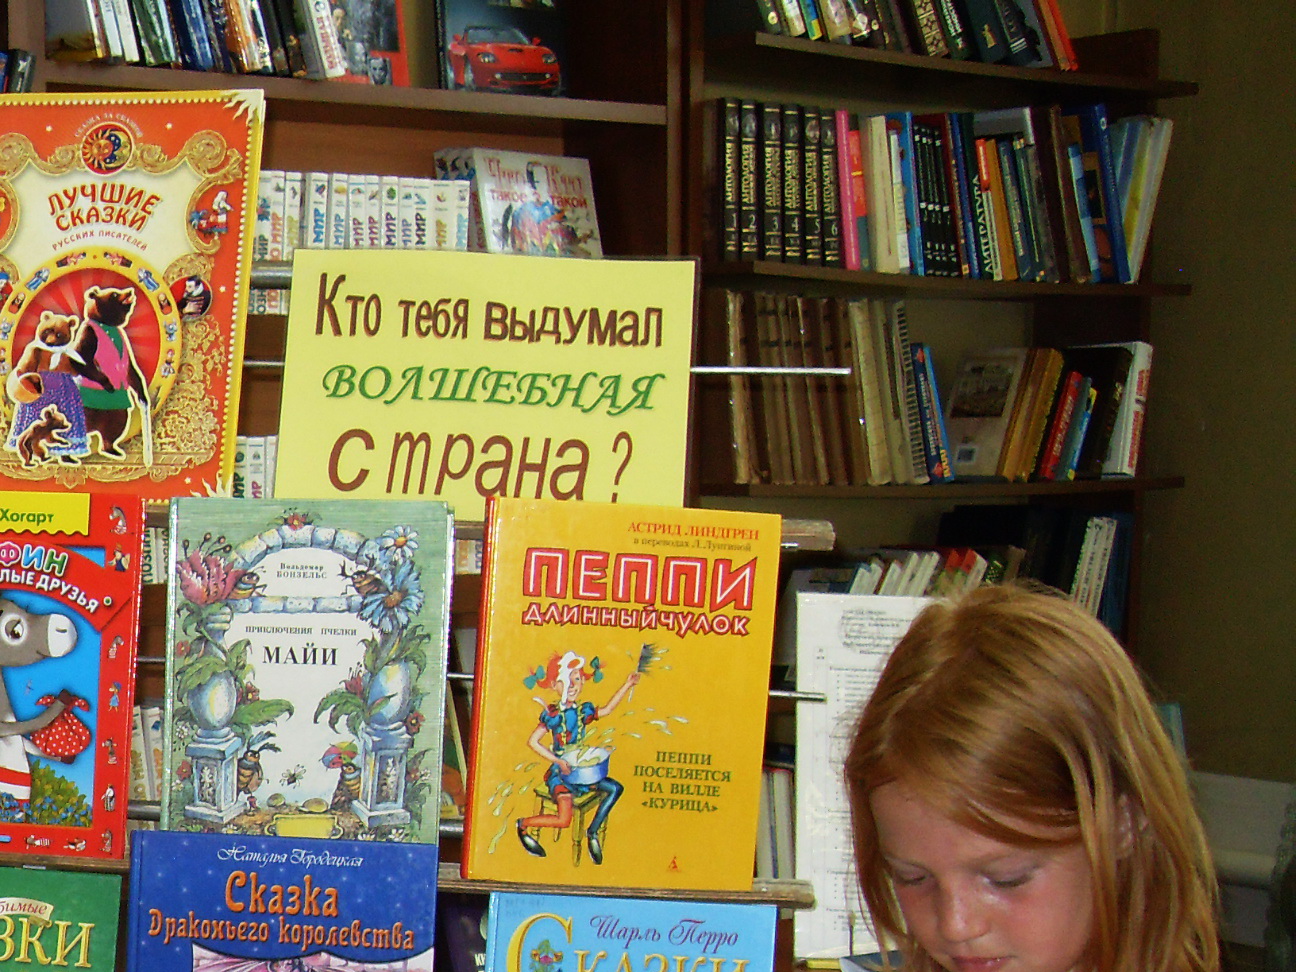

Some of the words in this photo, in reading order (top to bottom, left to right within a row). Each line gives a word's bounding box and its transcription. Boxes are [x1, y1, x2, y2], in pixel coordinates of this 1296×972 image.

[725, 142, 734, 202] АНТОЛОГИЯ
[741, 144, 751, 204] АНТОЛОГИЯ
[764, 147, 773, 207] АНТОЛОГИЯ
[784, 149, 793, 209] АНТОЛОГИЯ
[805, 152, 814, 211] АНТОЛОГИЯ
[823, 154, 832, 213] АНТОЛОГИЯ
[48, 182, 161, 217] ЛУЧШИЕ
[55, 205, 147, 232] СКАЗКИ
[312, 207, 326, 244] МИР
[334, 213, 346, 248] МИР
[353, 217, 365, 248] МИР
[368, 216, 380, 248] МИР
[385, 212, 397, 247] МИР
[415, 211, 428, 247] МИР
[971, 174, 994, 273] ЛИТЕРАТУРА
[52, 230, 95, 251] РУССКИХ
[98, 230, 148, 251] ПИСАТЕЛЕЙ
[315, 272, 382, 337] Кто
[398, 297, 470, 340] тебя
[483, 301, 664, 348] выдумал
[322, 363, 667, 416] ВОЛШЕБНАЯ
[0, 508, 54, 526] Хогарт
[627, 521, 683, 536] АСТРИД
[684, 524, 760, 541] ЛИНДГРЕН
[276, 570, 328, 580] БОНЗЕЛЬС
[523, 547, 758, 613] ПЕППИ
[38, 576, 100, 614] ДРУЗЬЯ
[245, 625, 313, 636] ПРИКЛЮЧЕНИЯ
[320, 627, 358, 637] ПЧЕЛКИ
[262, 642, 339, 667] МАЙИ
[633, 765, 732, 783] ПОСЕЛЯЕТСЯ
[656, 751, 713, 766] ПЕППИ
[641, 798, 718, 813] «КУРИЦА»
[642, 782, 664, 794] НА
[670, 783, 721, 797] ВИЛЛЕ
[217, 844, 287, 867] Наталья
[290, 848, 365, 868] Городецкая
[225, 870, 339, 918] Сказка
[148, 908, 269, 944] Драконьего
[278, 916, 415, 951] королевства
[589, 915, 662, 949] Шарль
[668, 918, 739, 954] Перро
